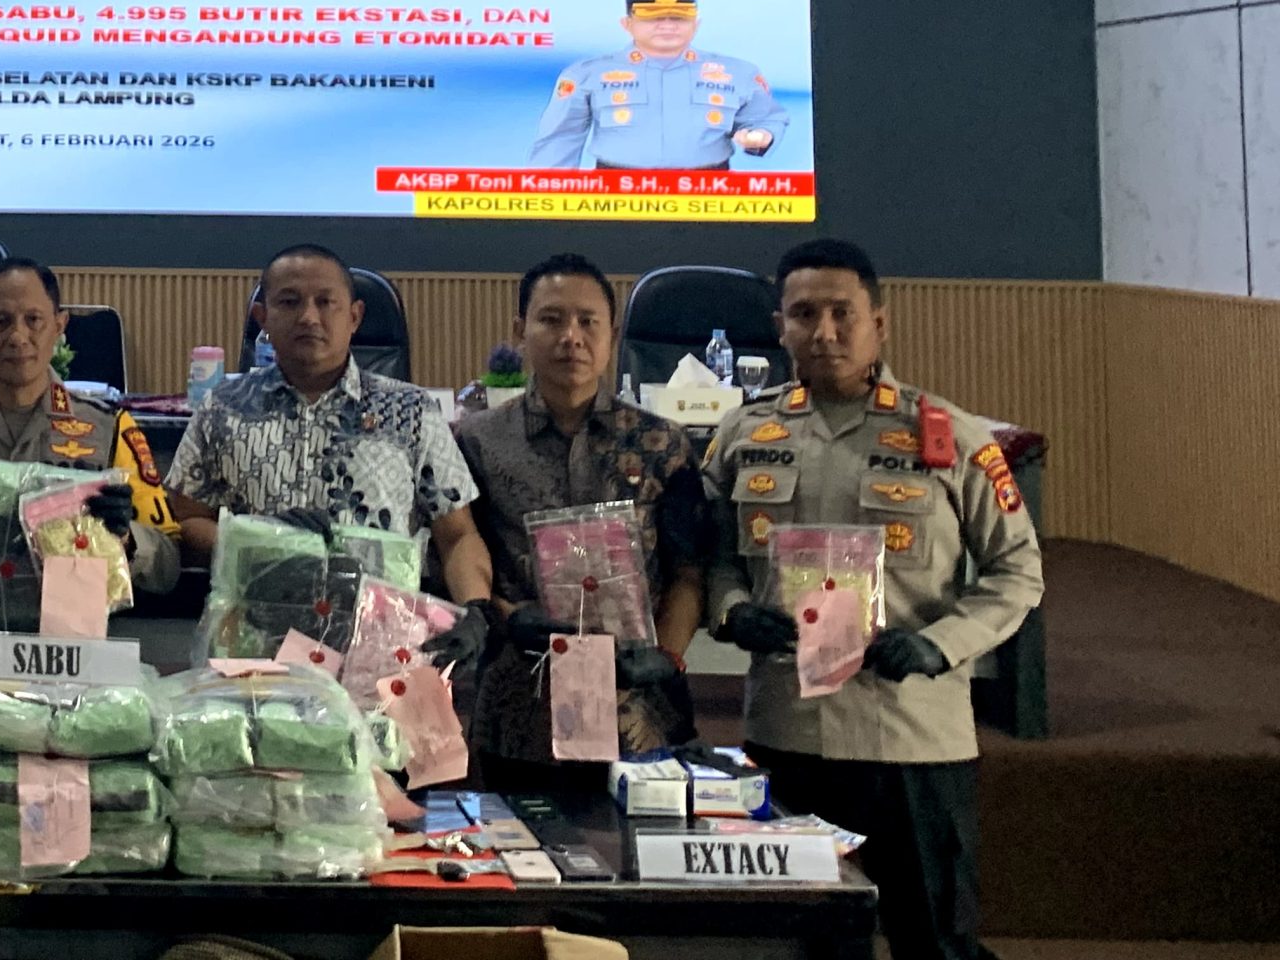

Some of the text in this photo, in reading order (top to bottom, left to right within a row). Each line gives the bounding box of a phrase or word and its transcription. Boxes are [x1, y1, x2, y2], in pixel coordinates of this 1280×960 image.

[96, 6, 187, 22] 4.995
[199, 6, 303, 23] BUTIR
[315, 7, 472, 25] EKSTASI,
[483, 8, 550, 23] DAN
[92, 28, 342, 45] MENGANDUNG
[354, 30, 555, 47] ETOMIDATE
[119, 71, 177, 87] DAN
[187, 72, 260, 88] KSKP
[270, 73, 436, 89] BAKAUHENI
[600, 81, 639, 89] TONI
[58, 90, 195, 107] LAMPUNG
[21, 134, 33, 146] 6
[42, 134, 153, 147] FEBRUARI
[160, 135, 215, 148] 2026
[395, 173, 459, 189] AKBP
[467, 173, 513, 190] Toni
[521, 174, 610, 193] Kasmiri,
[427, 197, 794, 215] KAPOLRES LAMPUNG SELATAN
[13, 643, 81, 676] SABU
[682, 841, 789, 876] EXTACY
